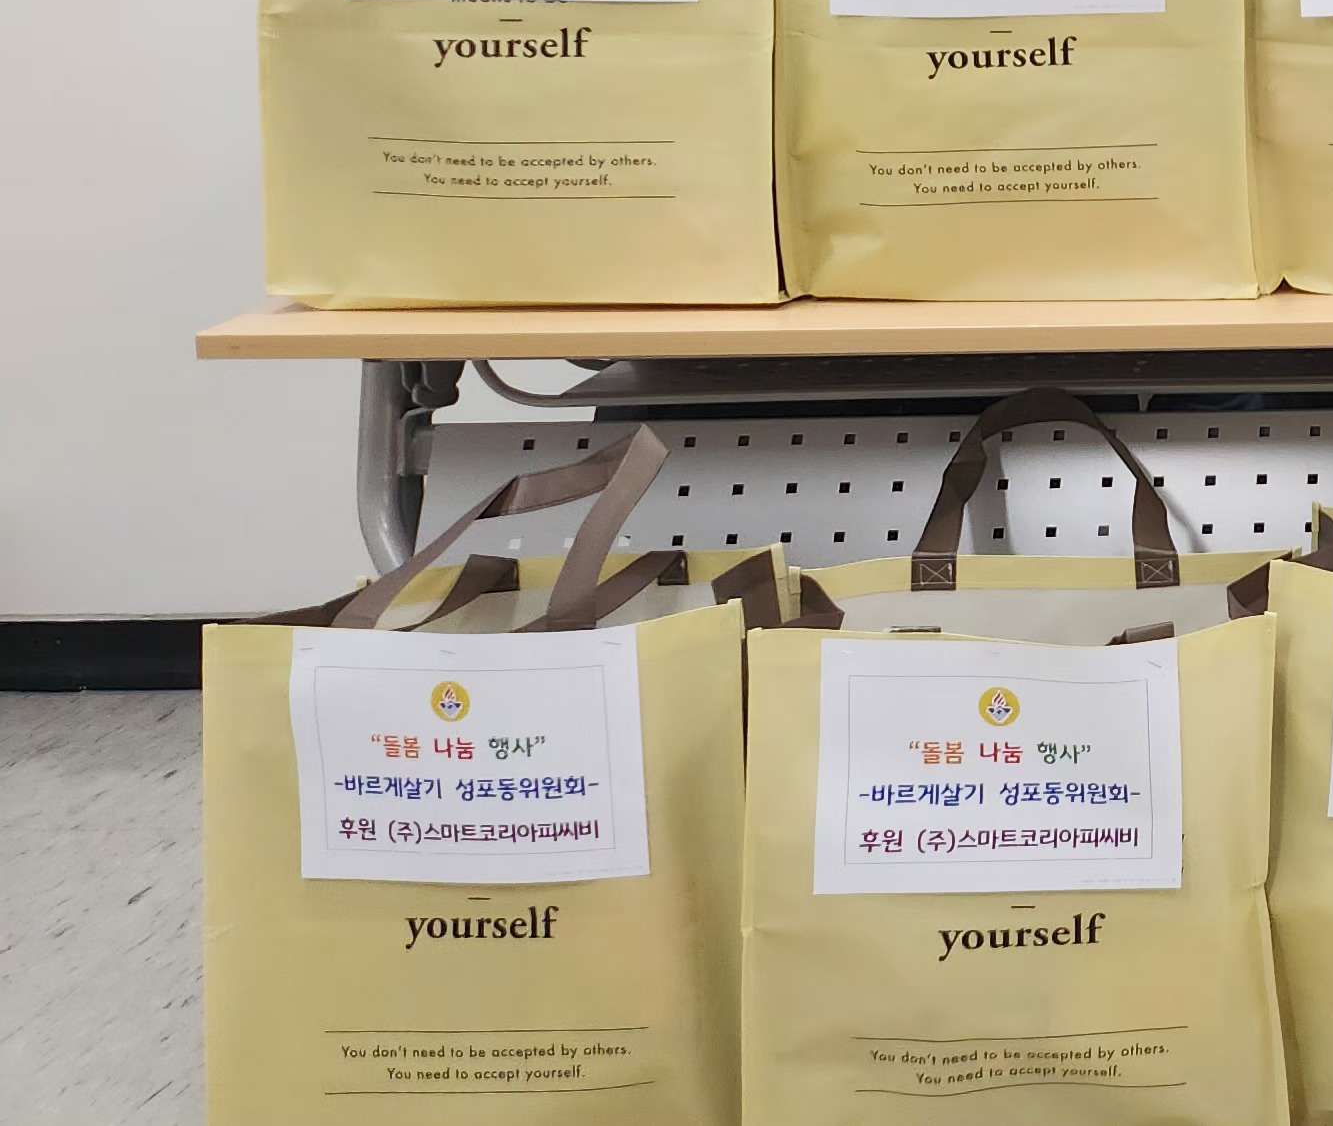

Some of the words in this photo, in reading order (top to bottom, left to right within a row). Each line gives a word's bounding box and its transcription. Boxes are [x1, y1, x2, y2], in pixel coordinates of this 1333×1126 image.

[433, 26, 593, 69] yourself
[925, 35, 1078, 80] yourself
[868, 163, 893, 176] You
[937, 161, 970, 175] need
[974, 163, 987, 174] to
[991, 161, 1008, 173] be
[1013, 159, 1072, 175] accepted
[1077, 159, 1093, 174] by
[913, 182, 938, 194] You
[942, 180, 975, 193] need
[979, 182, 992, 193] to
[997, 181, 1040, 193] accept
[433, 737, 476, 760] 나눔
[979, 741, 1024, 764] 나눔
[338, 816, 377, 841] 후원
[388, 819, 600, 845] (주)스마트코리아피씨비
[859, 828, 903, 854] 후원
[917, 827, 1139, 854] (주)스마트코리아피씨비
[405, 905, 560, 950] yourself
[937, 912, 1107, 962] yourself
